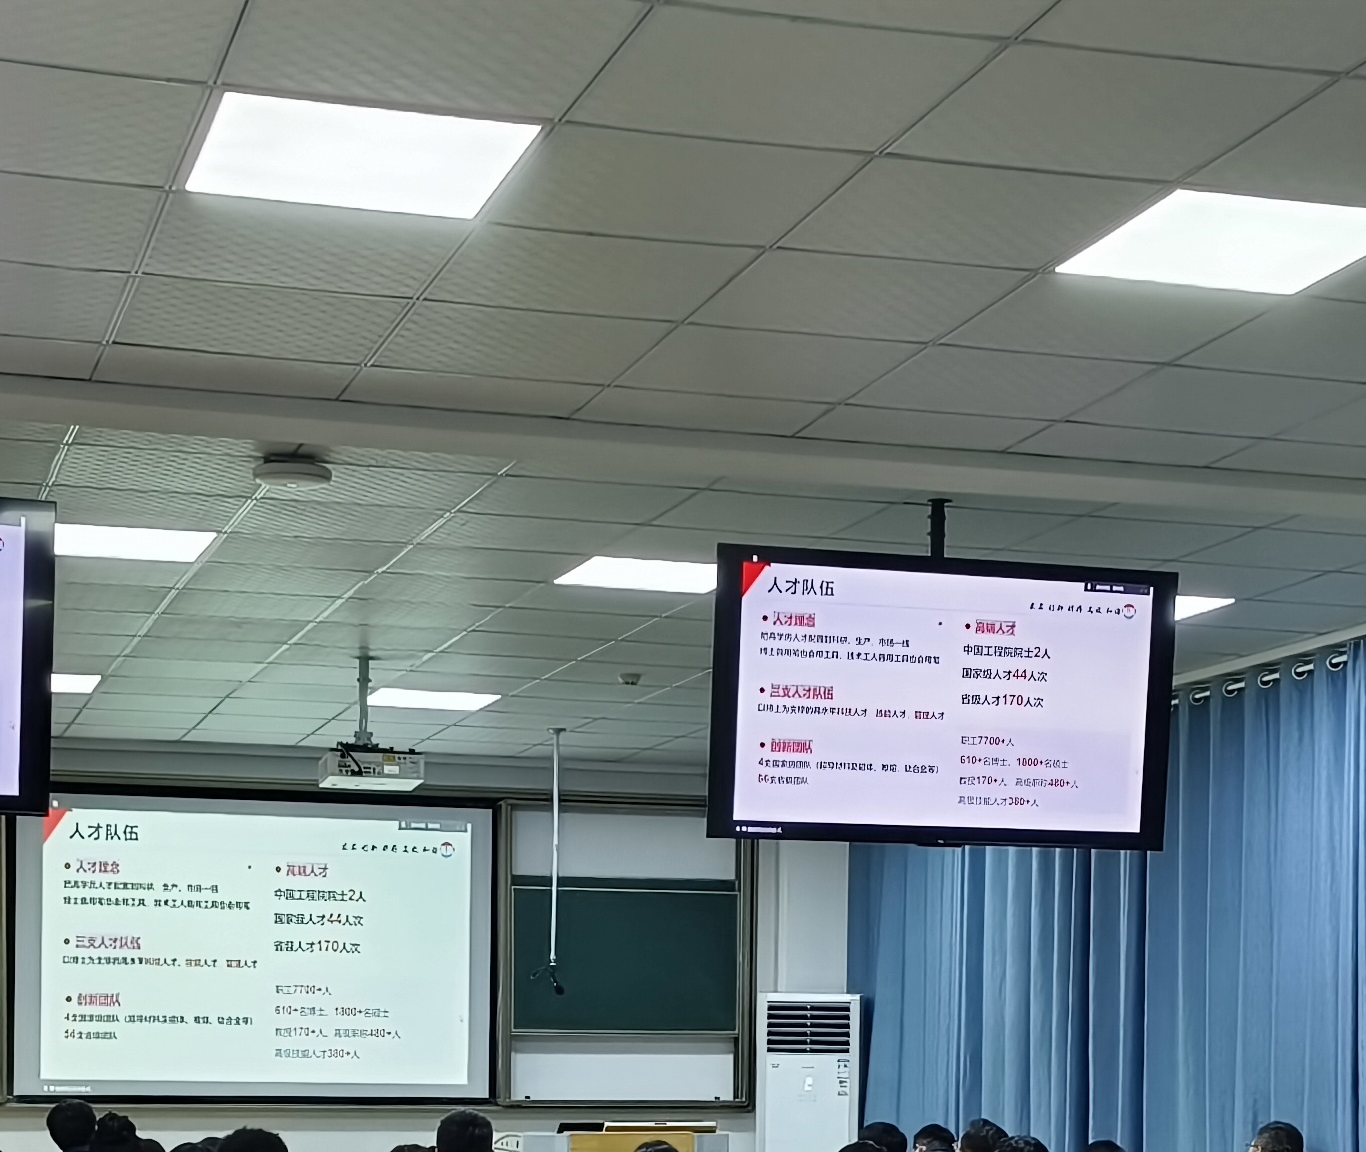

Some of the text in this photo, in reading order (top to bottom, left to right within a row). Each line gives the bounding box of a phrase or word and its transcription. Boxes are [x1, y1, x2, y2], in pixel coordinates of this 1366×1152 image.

[767, 577, 835, 597] 人才队伍
[963, 645, 1051, 660] 中国工程院院士2人
[961, 667, 1048, 683] 国家级人才44人次
[769, 684, 834, 700] 三支人才队伍
[961, 693, 1044, 708] 省级人才170人次
[69, 822, 140, 842] 人才队伍
